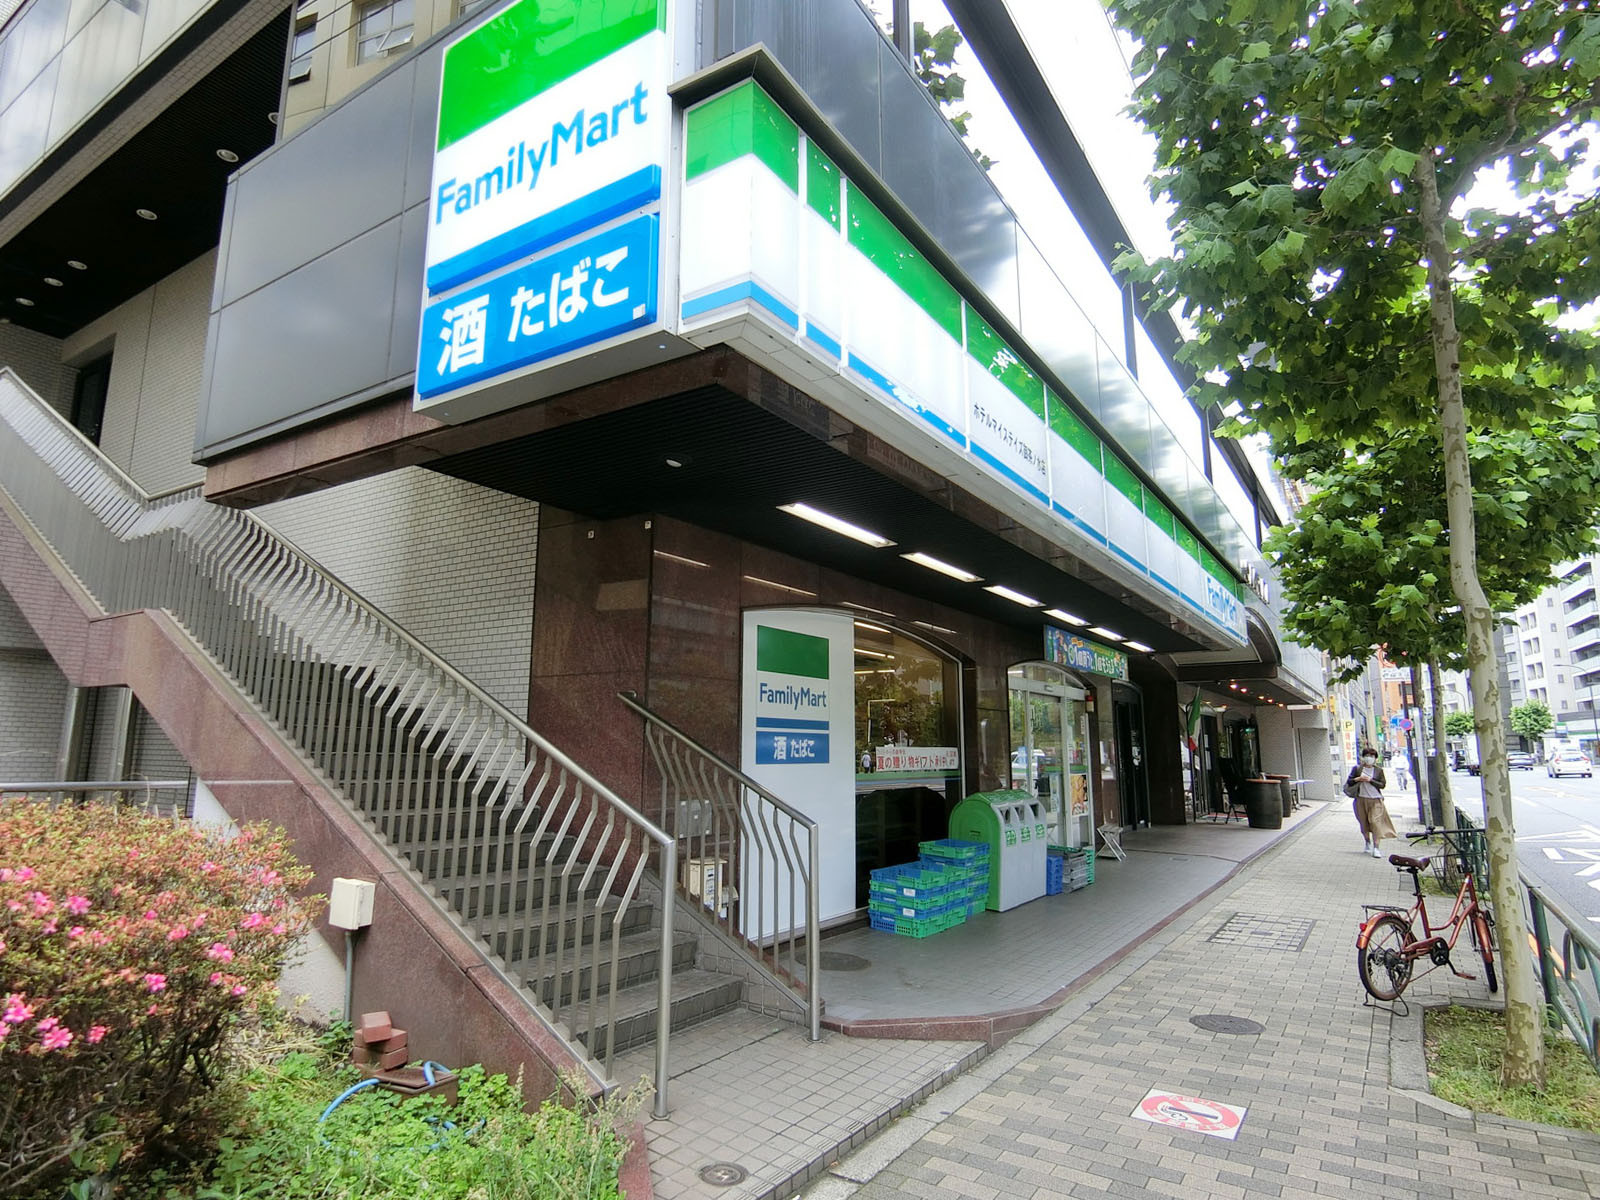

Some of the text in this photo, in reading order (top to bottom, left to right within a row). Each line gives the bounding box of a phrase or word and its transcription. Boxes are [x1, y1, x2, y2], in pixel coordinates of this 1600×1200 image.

[436, 81, 648, 225] FamilyMart
[437, 246, 629, 376] 酒 たばこ
[1207, 577, 1241, 625] FamilyMa
[759, 682, 827, 711] FamilyMart
[1345, 721, 1353, 729] P
[774, 736, 815, 760] 酒 たばこ
